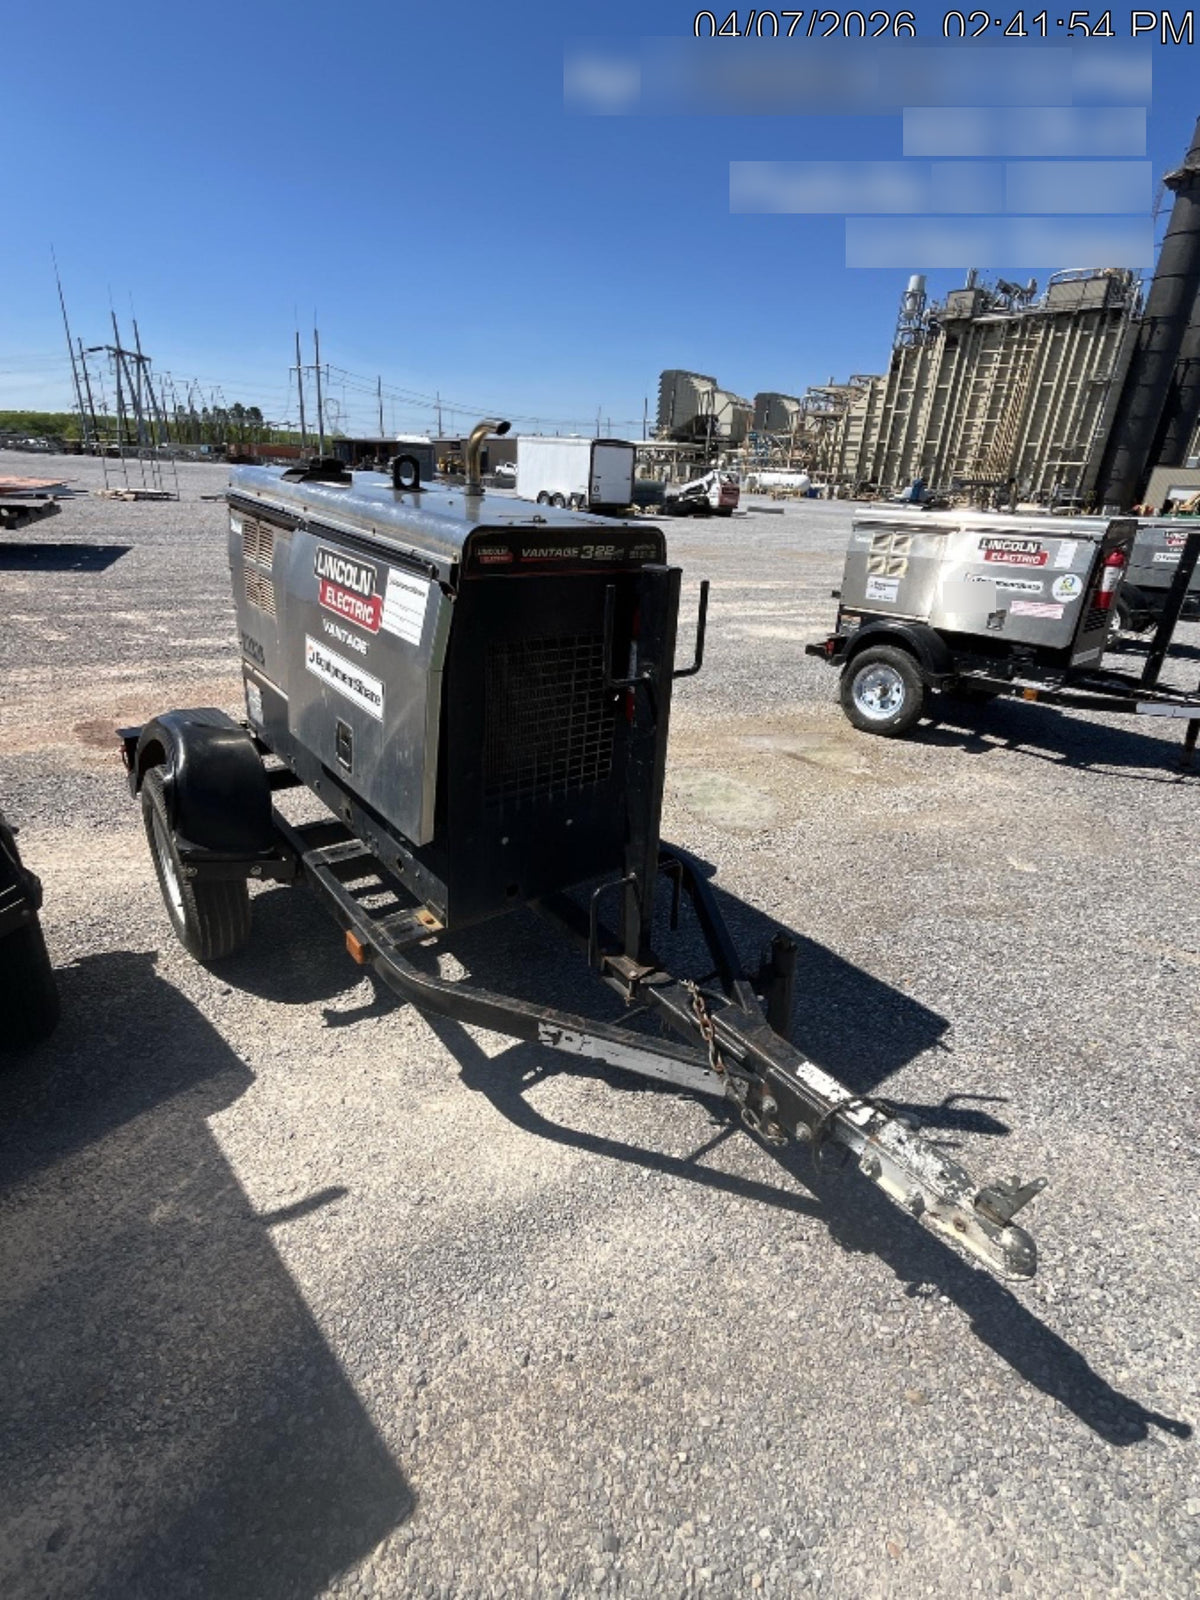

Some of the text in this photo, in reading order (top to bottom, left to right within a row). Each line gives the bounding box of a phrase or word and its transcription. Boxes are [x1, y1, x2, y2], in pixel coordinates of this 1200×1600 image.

[521, 547, 579, 558] VANTAGE
[981, 538, 1038, 554] LINCOLN
[991, 552, 1042, 565] ELECTRIC
[317, 550, 373, 597] LINCOLN
[325, 585, 375, 625] ELECTRIC
[322, 617, 369, 656] VANTAGE
